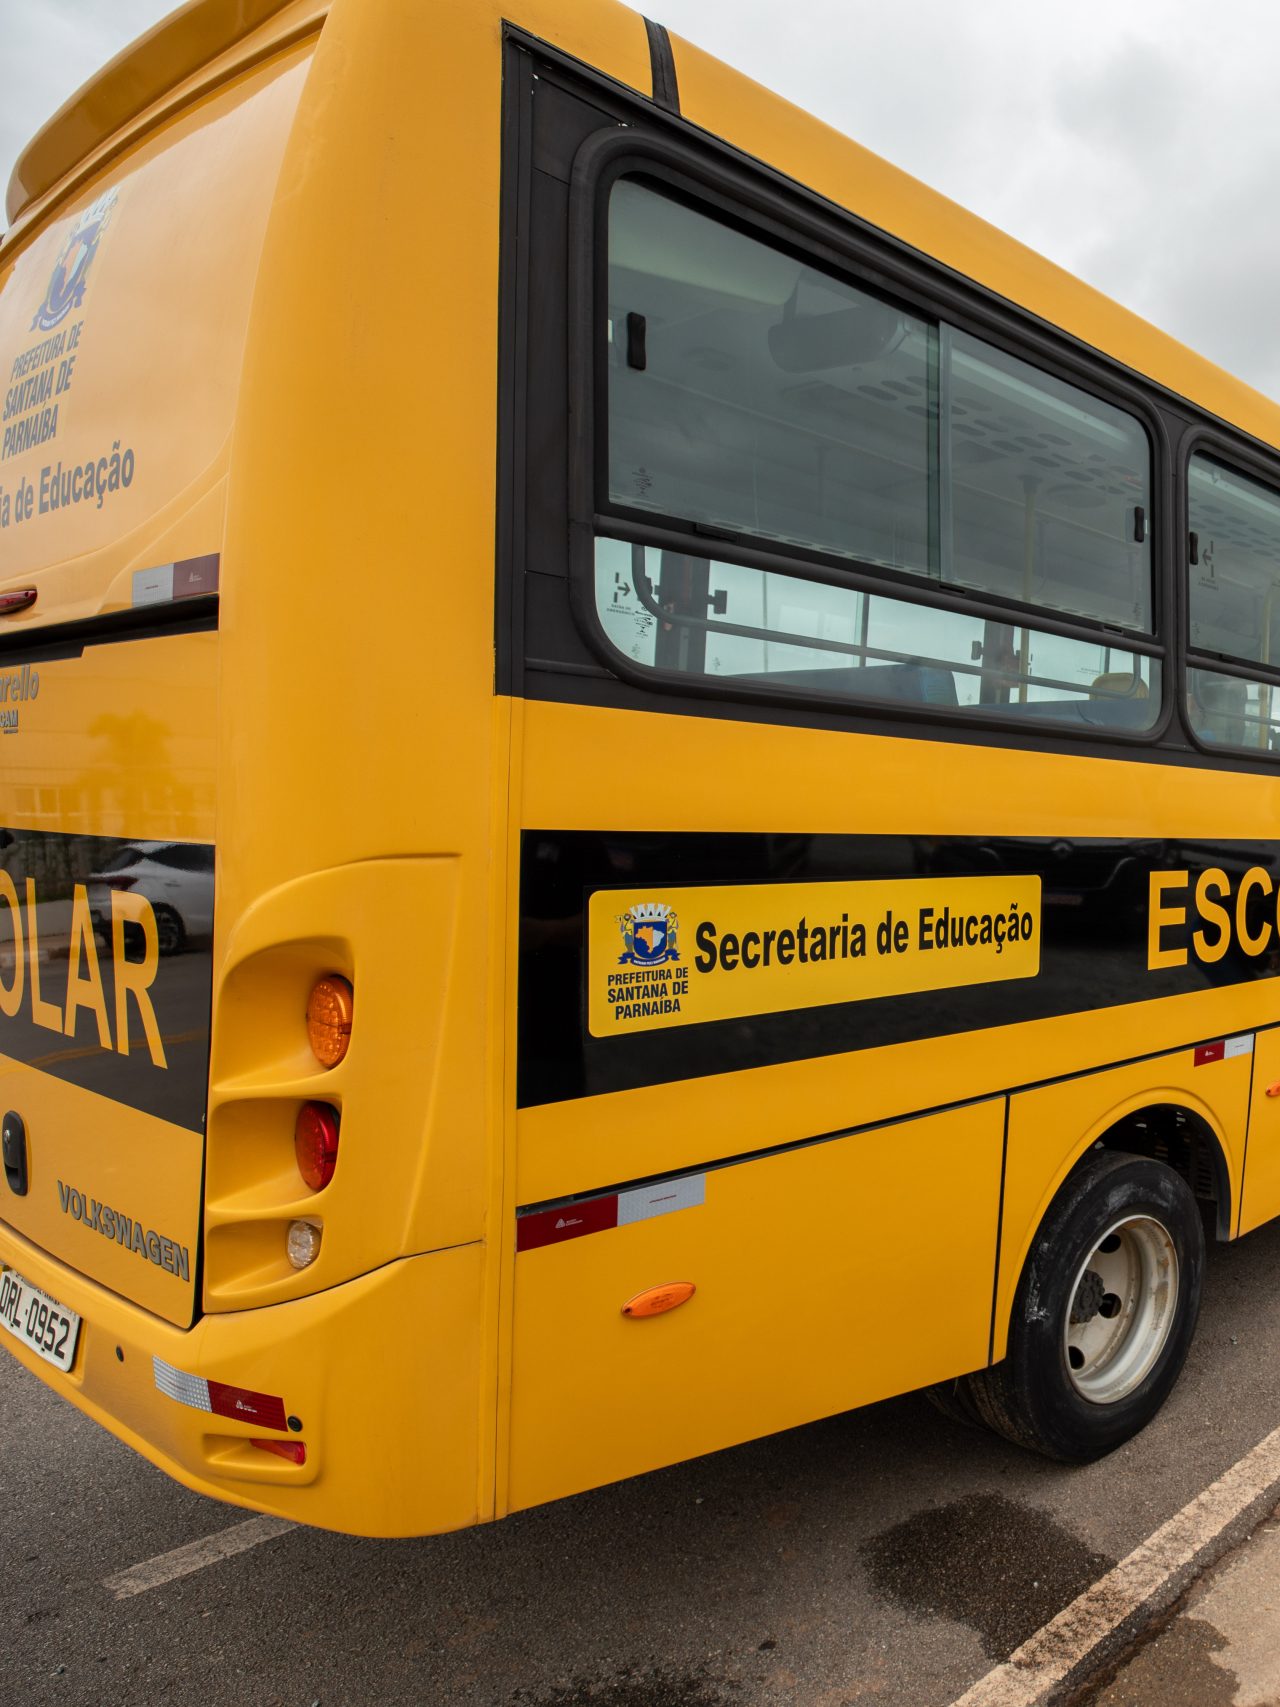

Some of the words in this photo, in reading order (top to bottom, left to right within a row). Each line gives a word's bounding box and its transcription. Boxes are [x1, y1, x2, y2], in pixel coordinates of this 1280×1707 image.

[9, 330, 67, 383] PREFEITURA
[67, 321, 84, 352] DE
[3, 366, 55, 422] SANTANA
[55, 356, 77, 395] DE
[1, 402, 59, 461] PARNAÍBA
[15, 476, 34, 523] de
[38, 440, 135, 515] Educação
[694, 913, 866, 973] Secretaria
[876, 910, 909, 954] de
[918, 903, 1033, 954] Educação
[607, 968, 672, 986] PREFEITURA
[676, 967, 688, 979] DE
[607, 983, 668, 1003] SANTANA
[672, 981, 688, 995] DE
[615, 997, 681, 1020] PARNAÍBA
[57, 1180, 190, 1282] VOLKSWAGEN
